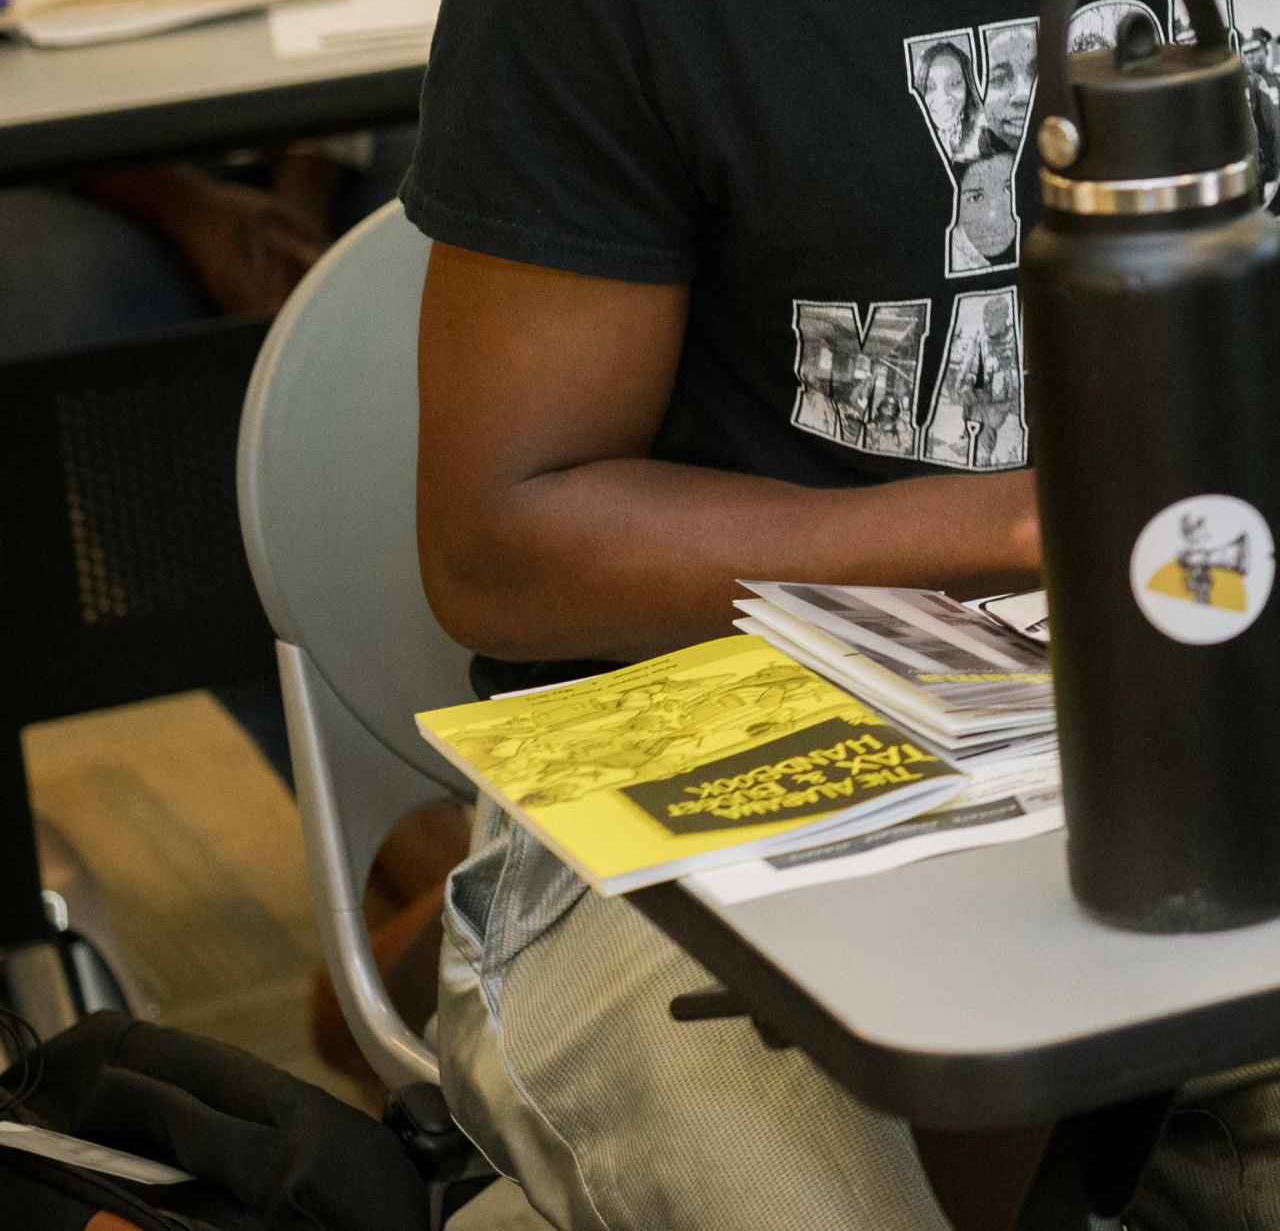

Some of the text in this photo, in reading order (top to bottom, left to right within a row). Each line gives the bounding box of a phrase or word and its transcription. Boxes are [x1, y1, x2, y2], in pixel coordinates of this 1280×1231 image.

[667, 743, 939, 818] TAX & BUDGET
[683, 733, 883, 799] HANDBOOK
[711, 766, 923, 820] THE ALABAMA
